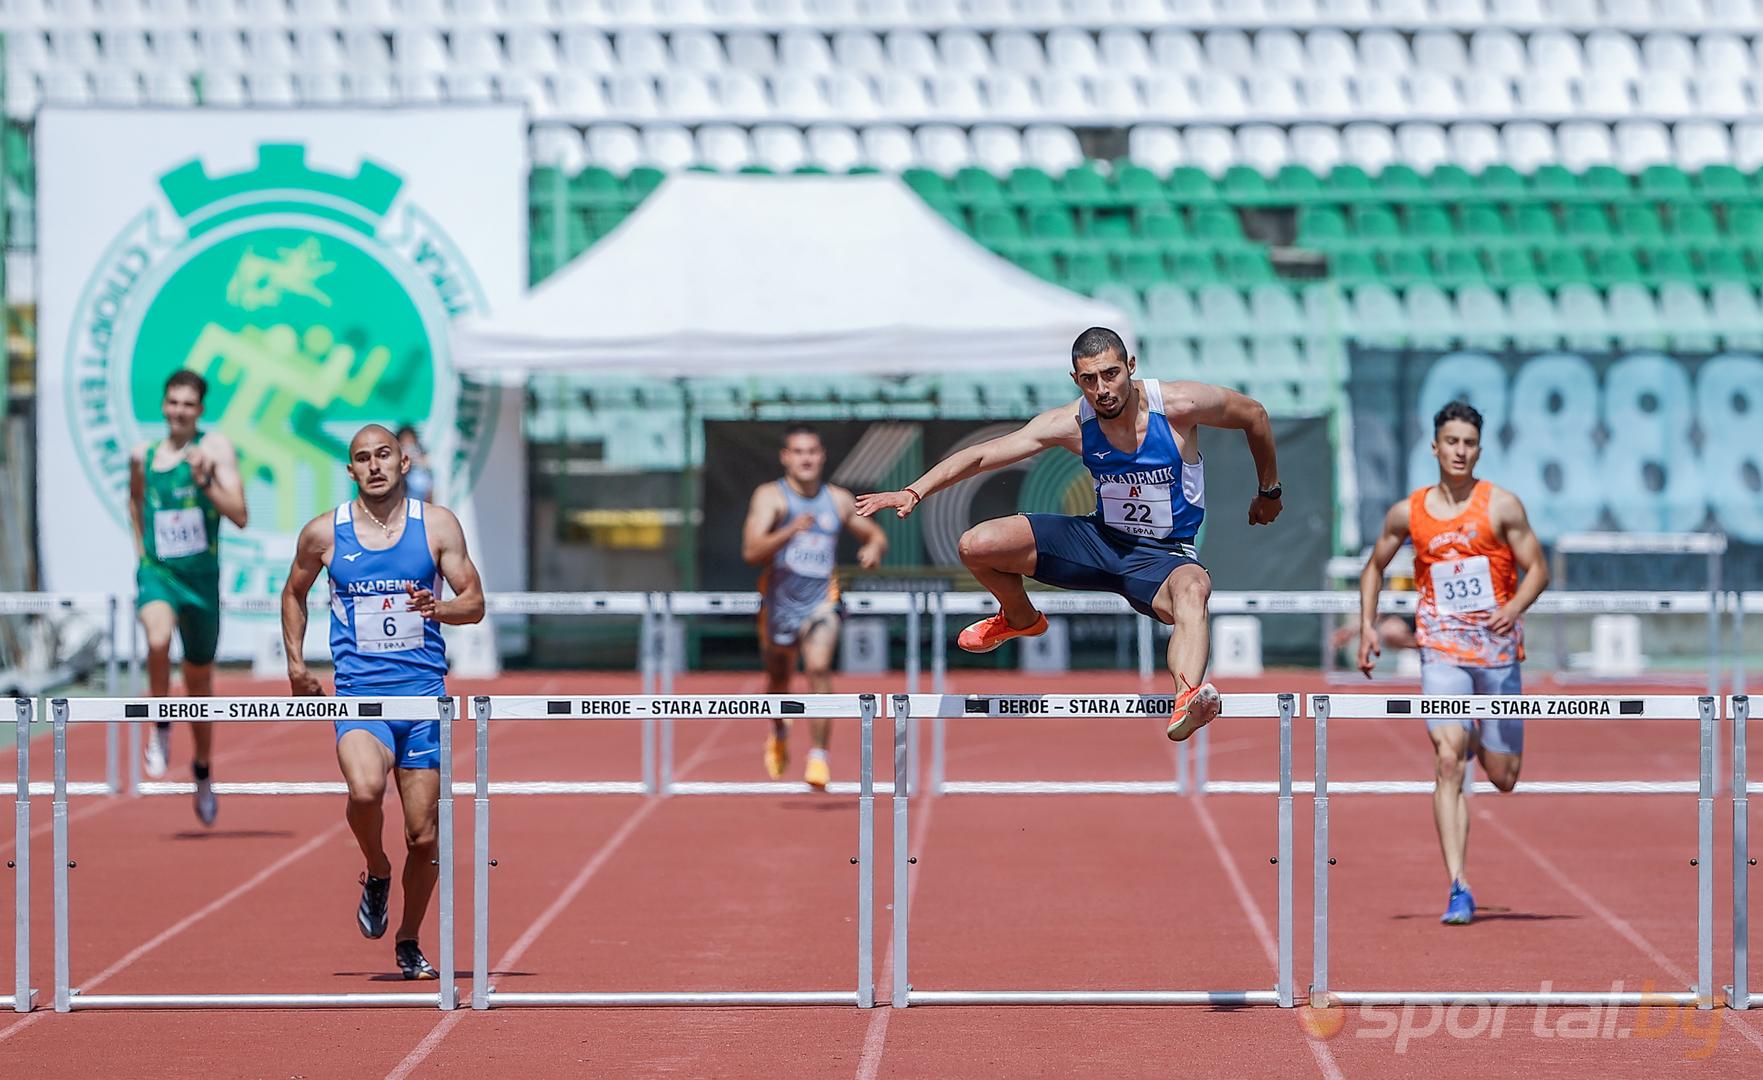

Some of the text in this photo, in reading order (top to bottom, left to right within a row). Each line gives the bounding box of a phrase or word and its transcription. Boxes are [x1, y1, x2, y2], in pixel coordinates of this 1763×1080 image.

[1100, 466, 1174, 485] AKADEMIK
[1122, 503, 1152, 524] 22
[1444, 577, 1482, 601] 333
[383, 616, 397, 637] 6
[158, 702, 209, 717] BEROE
[229, 702, 280, 717] STARA
[286, 702, 349, 717] ZAGORA
[581, 700, 631, 715] BEROE
[651, 700, 701, 715] STARA
[708, 700, 771, 715] ZAGORA
[999, 699, 1049, 714] BEROE
[1069, 699, 1120, 714] STARA
[1125, 699, 1175, 714] ZAGOR
[1420, 700, 1471, 715] BEROE
[1490, 700, 1541, 715] STARA
[1547, 700, 1610, 715] ZAGORA
